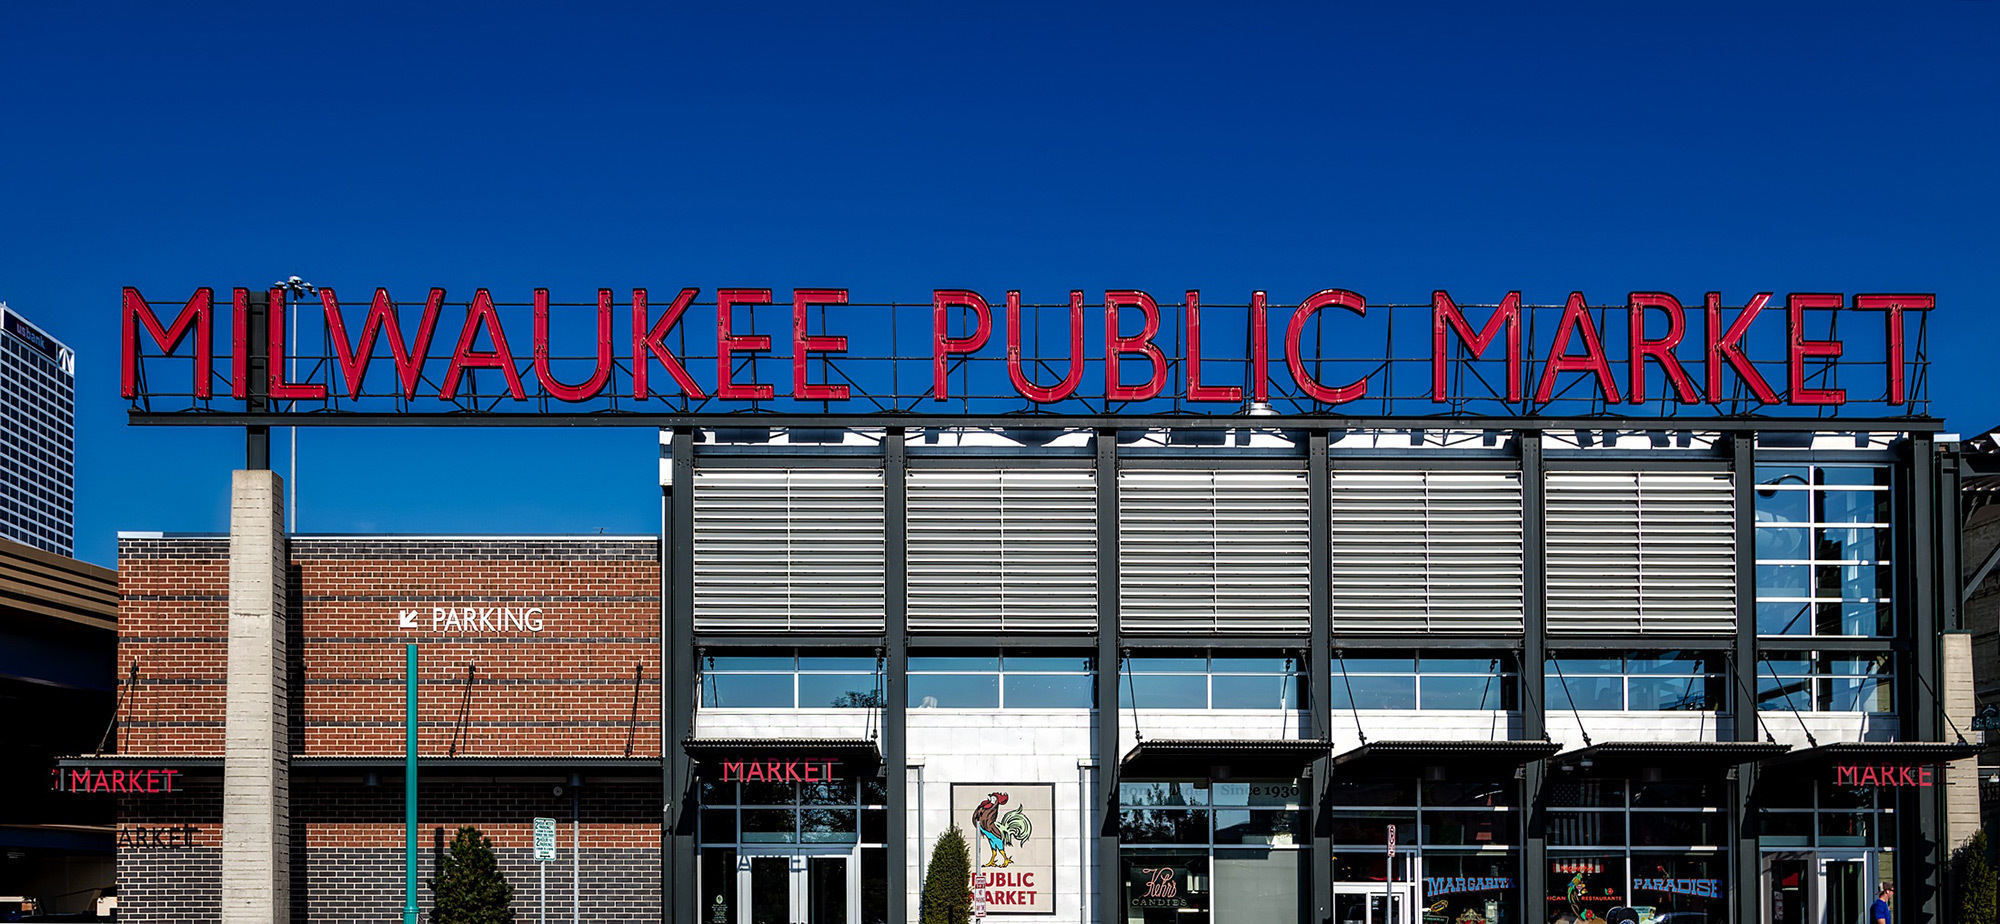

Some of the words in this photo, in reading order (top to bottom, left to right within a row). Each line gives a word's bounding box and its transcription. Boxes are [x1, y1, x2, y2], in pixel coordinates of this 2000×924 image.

[121, 286, 850, 402] MILWAUKEE
[932, 287, 1367, 404] PUBLIC
[1430, 290, 1936, 407] MARKET
[432, 607, 544, 632] PARKING
[72, 769, 178, 793] MARKET
[723, 757, 839, 783] MARKET
[1836, 761, 1946, 787] MARKE
[1221, 784, 1261, 797] Since
[1264, 785, 1300, 799] 1930
[969, 890, 1037, 905] ARKET
[1633, 877, 1723, 899] PARADISE
[1132, 898, 1188, 907] CANDIES
